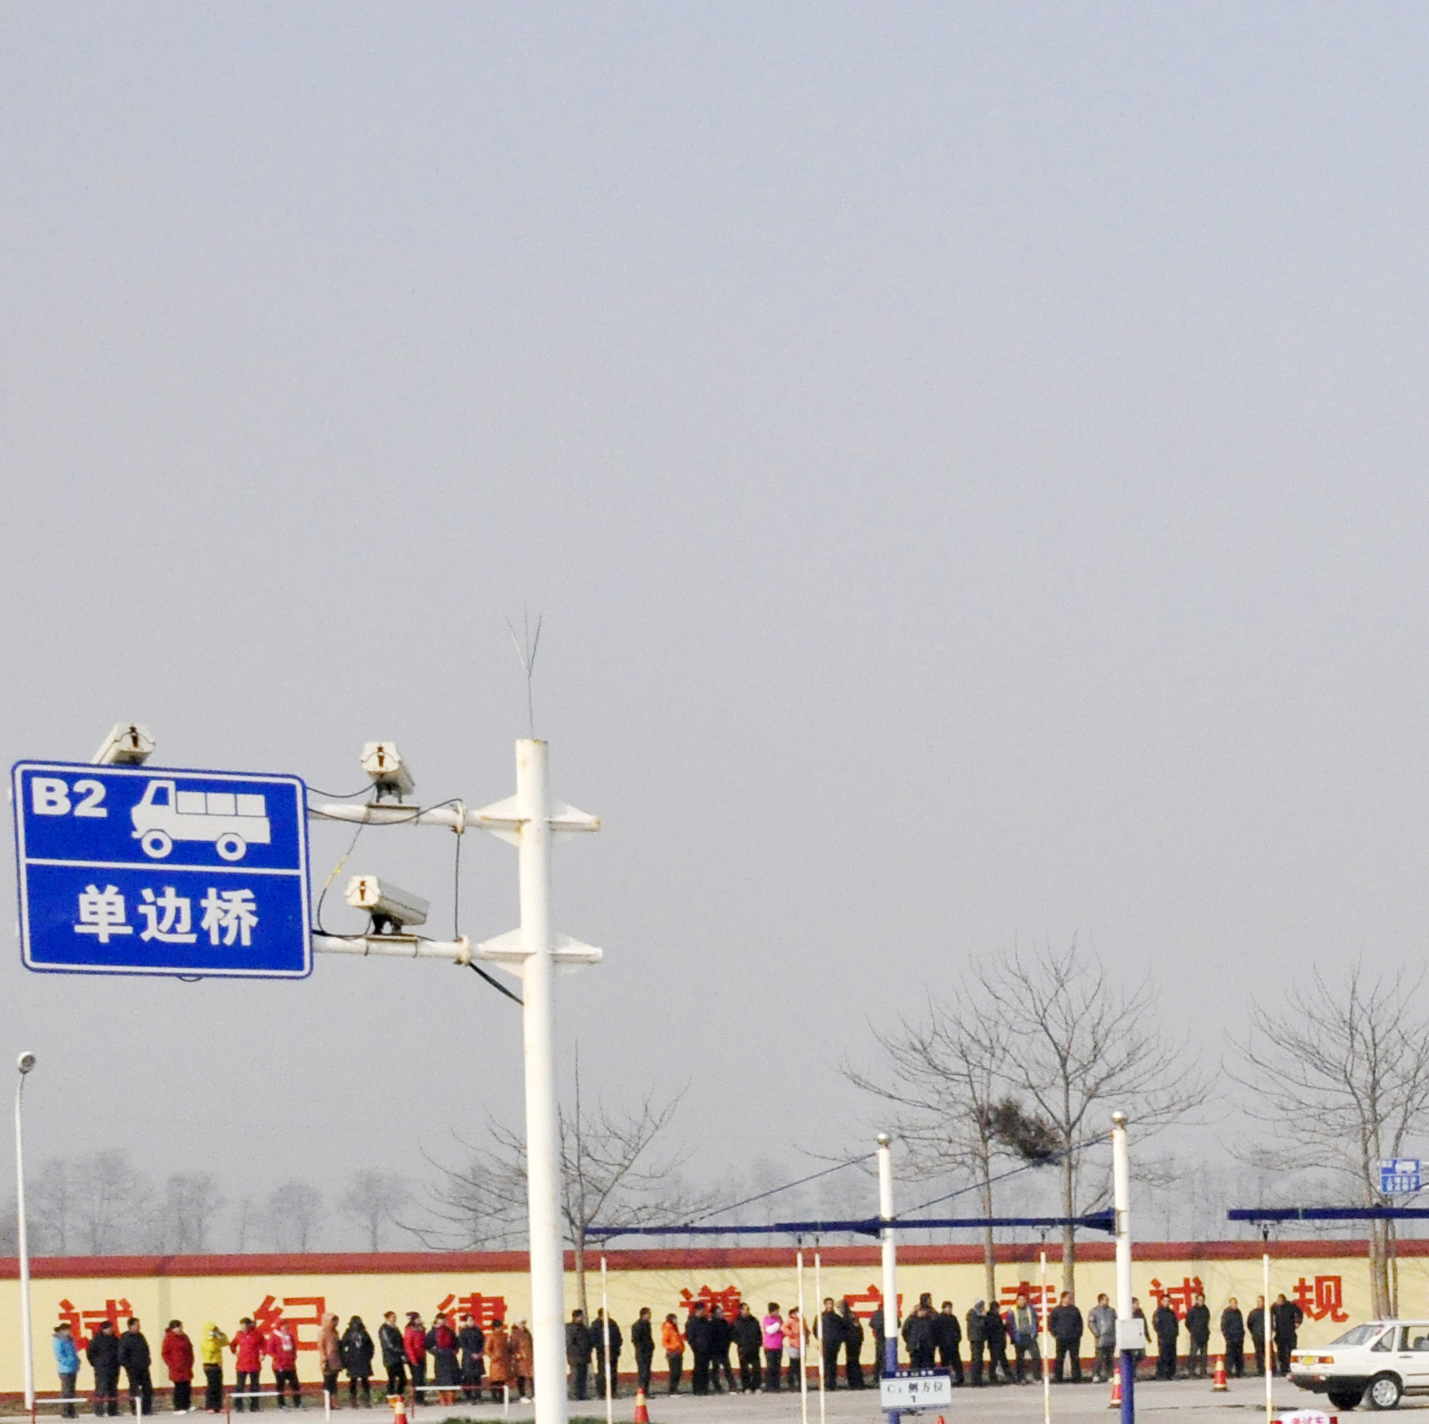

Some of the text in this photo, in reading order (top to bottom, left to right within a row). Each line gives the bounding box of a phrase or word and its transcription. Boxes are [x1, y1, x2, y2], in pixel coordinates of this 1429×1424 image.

[31, 777, 108, 817] B2
[74, 884, 259, 946] 单边桥
